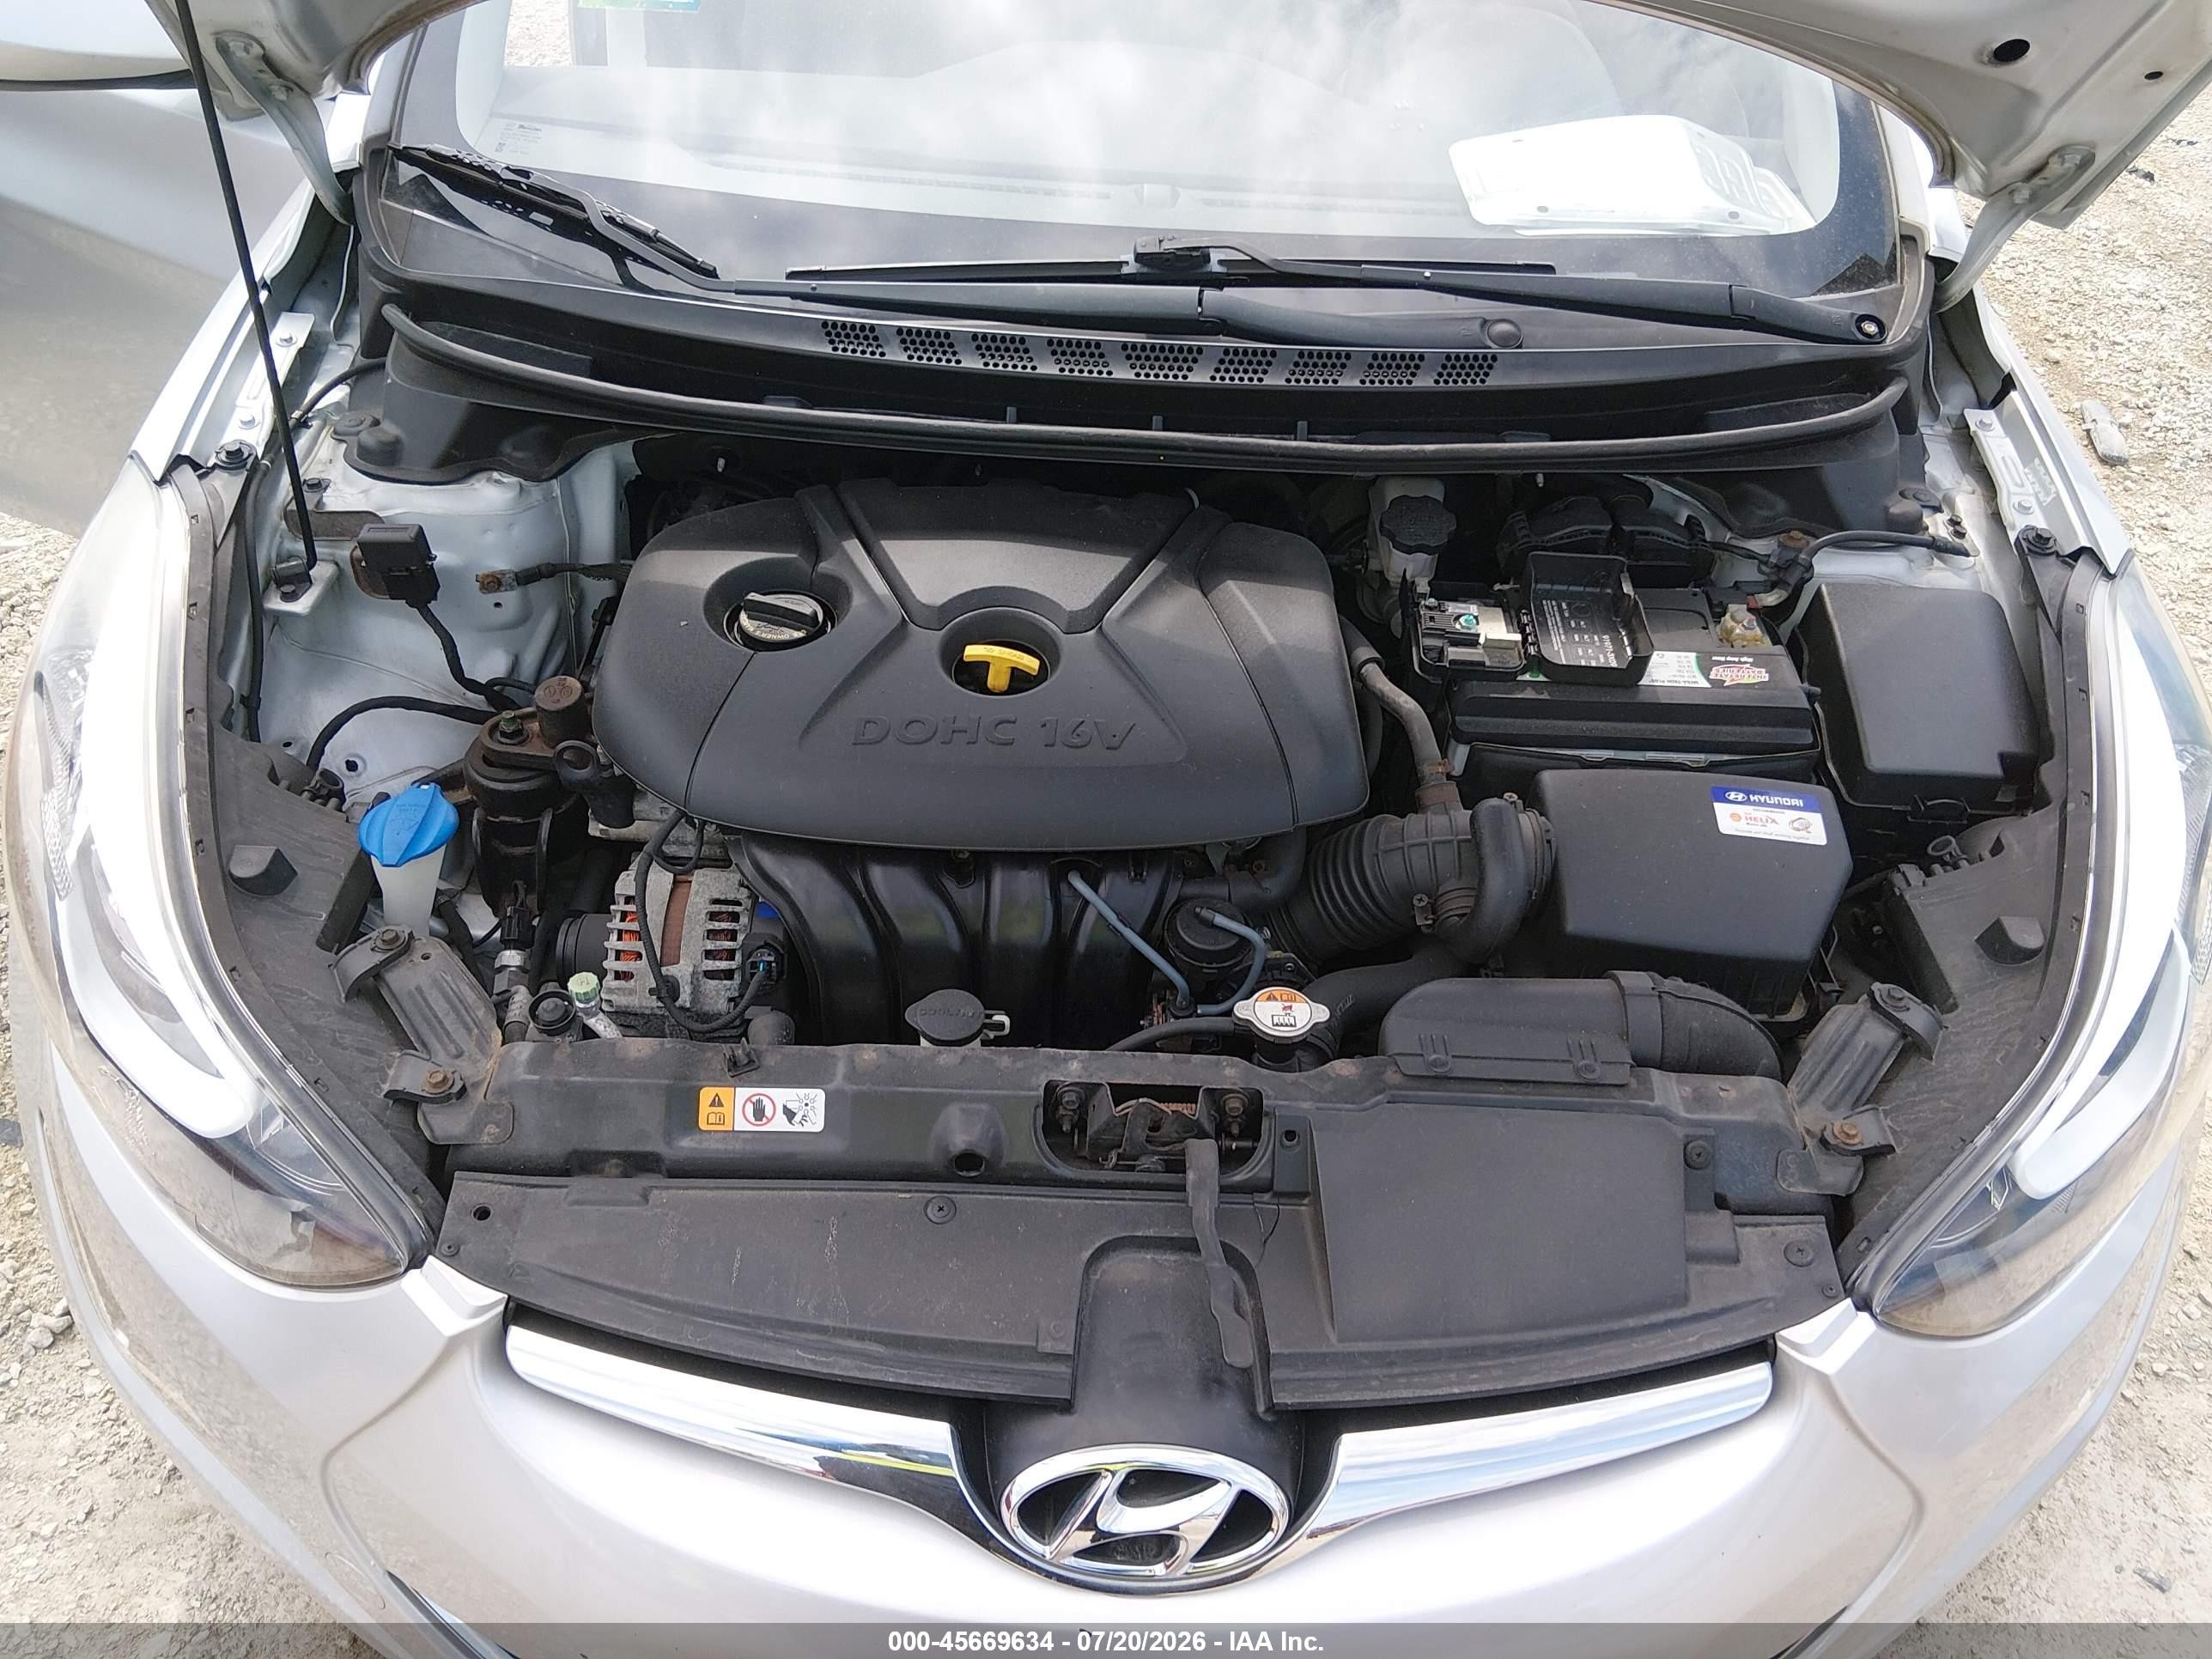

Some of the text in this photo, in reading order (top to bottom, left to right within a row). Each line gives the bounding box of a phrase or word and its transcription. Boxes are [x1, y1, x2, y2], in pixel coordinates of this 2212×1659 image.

[756, 631, 790, 640] OWNER'S
[852, 715, 1137, 750] DOHC 16V
[1748, 793, 1804, 807] HYUNDAI
[1744, 814, 1779, 825] HELIX
[920, 1008, 976, 1018] COOLANT
